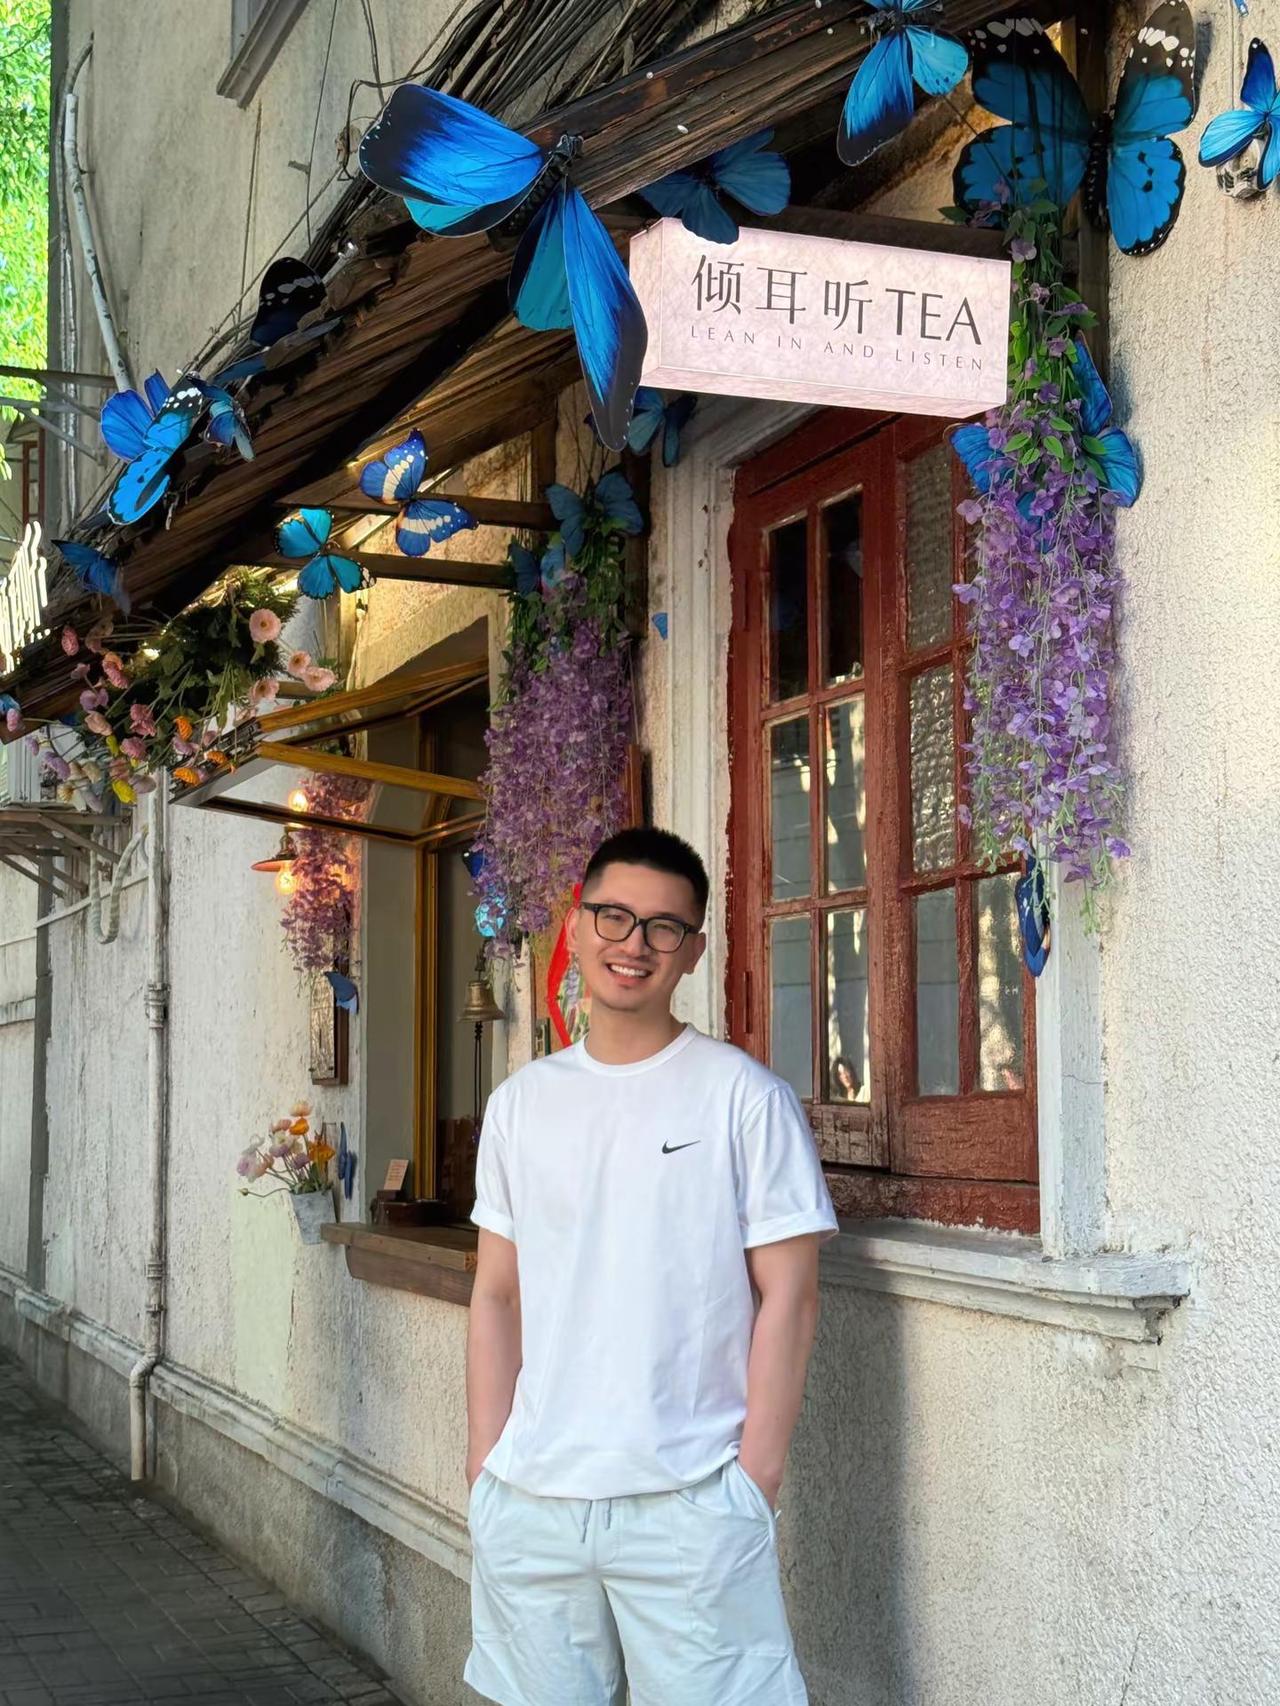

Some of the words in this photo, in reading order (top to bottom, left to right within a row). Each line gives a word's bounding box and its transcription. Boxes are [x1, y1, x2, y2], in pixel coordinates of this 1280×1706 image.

[691, 254, 873, 335] 倾耳听
[885, 288, 983, 346] TEA
[691, 324, 756, 344] LEAN
[777, 335, 803, 351] IN
[823, 340, 874, 359] AND
[895, 348, 984, 370] LISTEN
